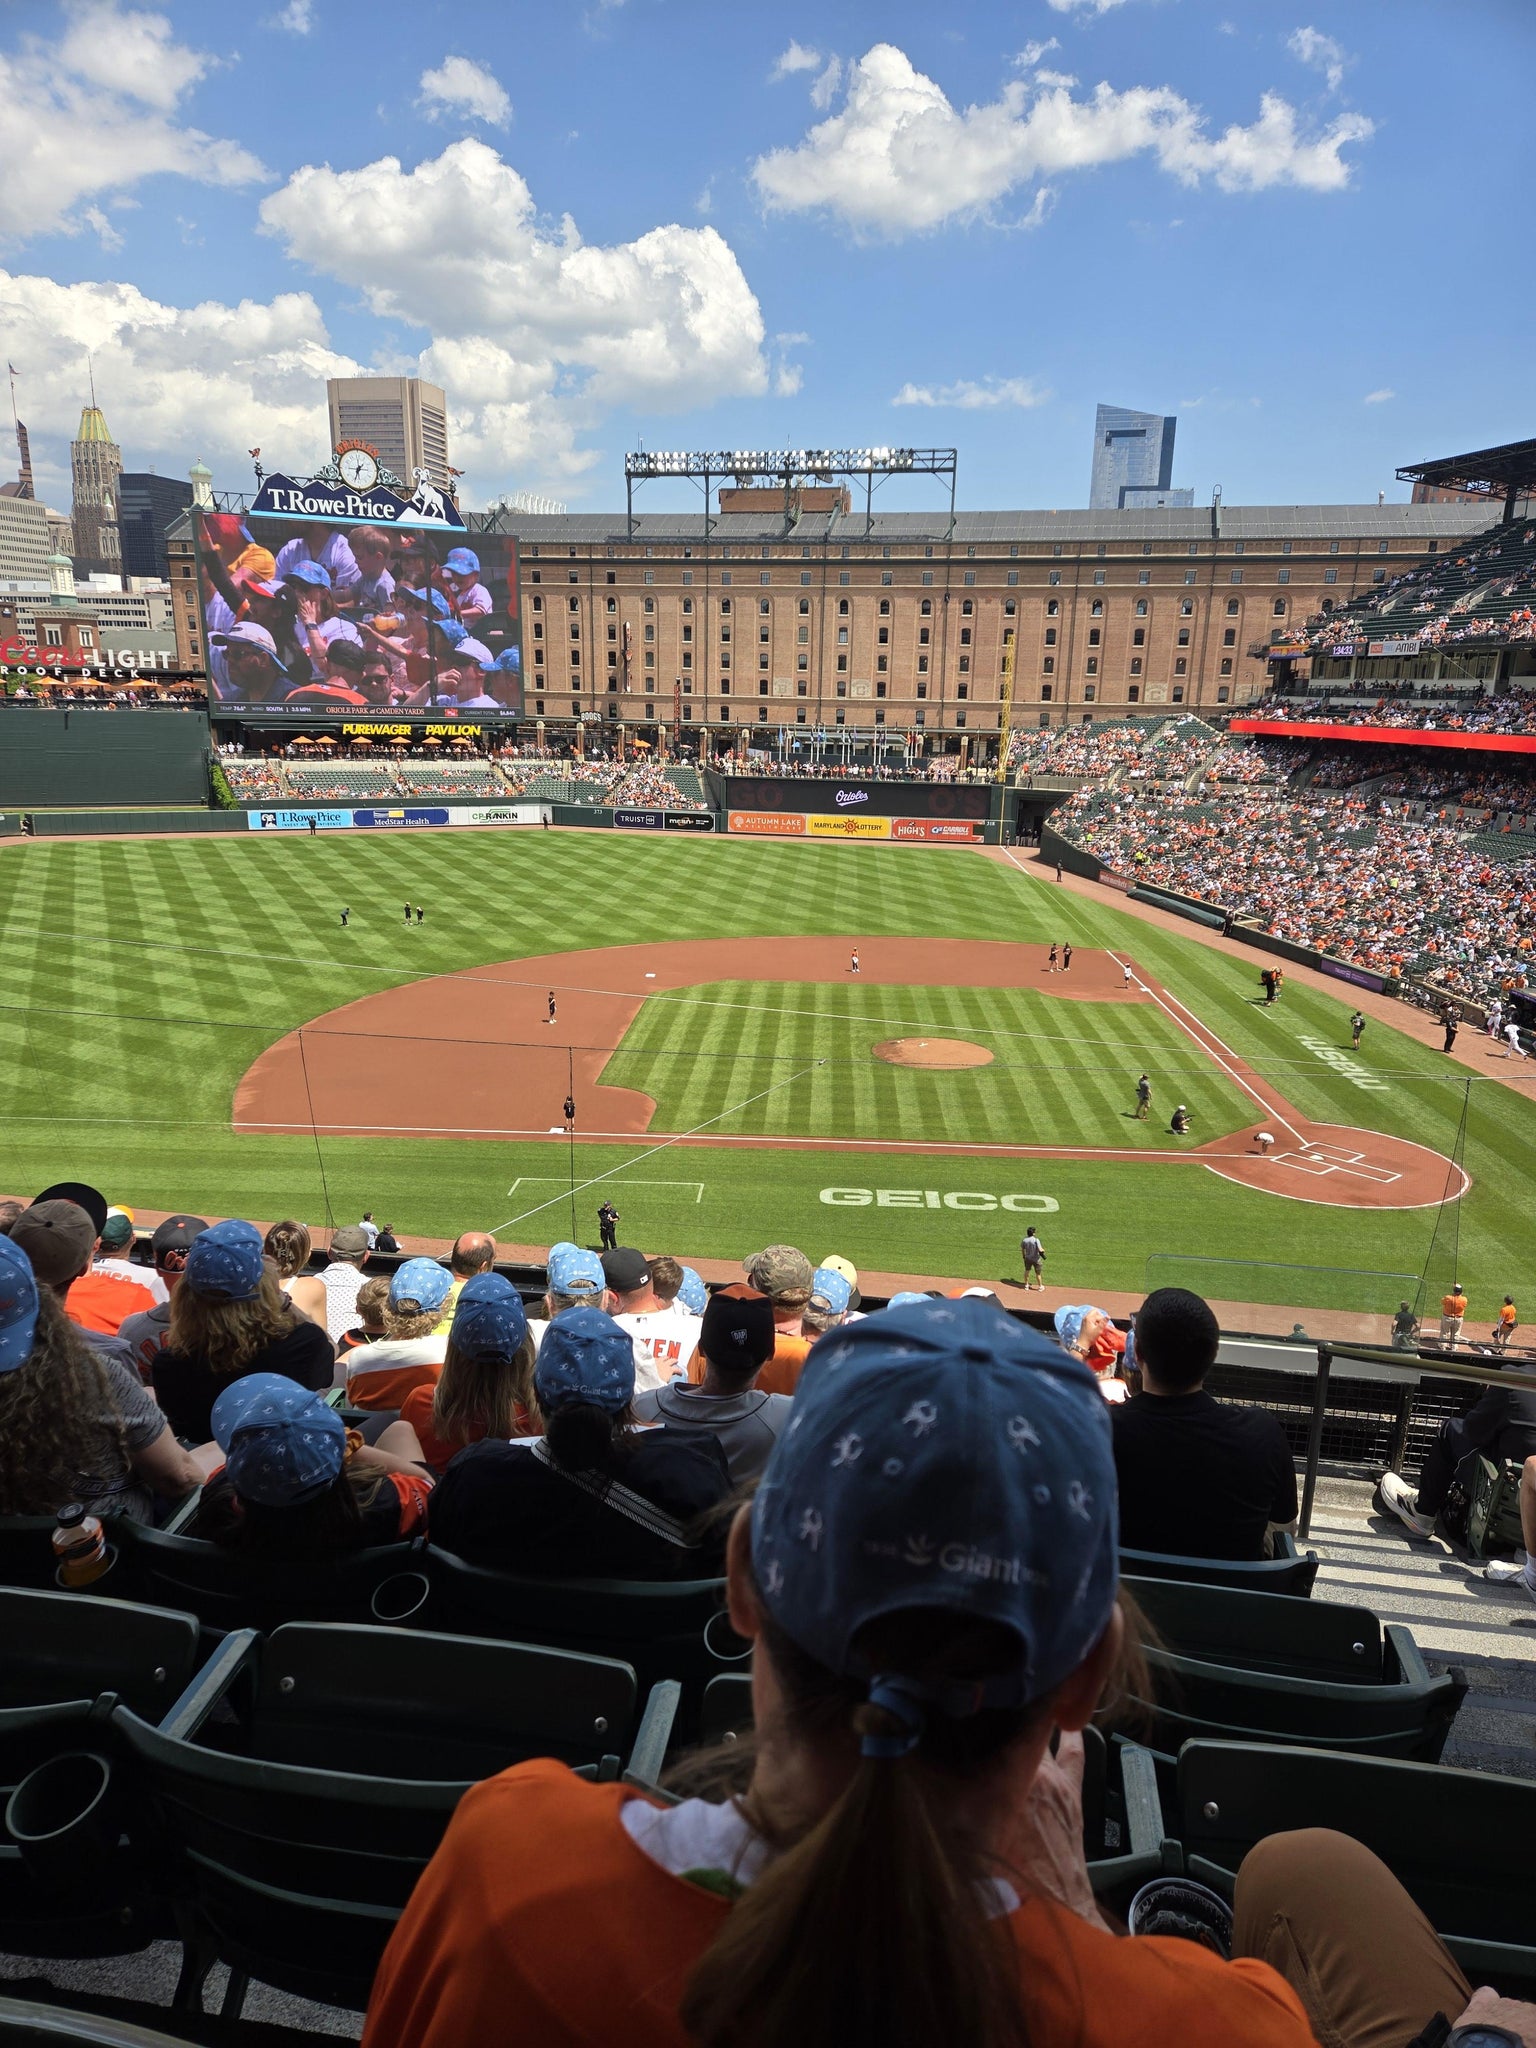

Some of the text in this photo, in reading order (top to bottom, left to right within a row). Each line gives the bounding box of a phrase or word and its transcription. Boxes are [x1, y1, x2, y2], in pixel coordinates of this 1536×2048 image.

[346, 494, 396, 520] Price
[0, 635, 171, 669] Coors LIGHT
[0, 665, 140, 678] ROOF DECK
[326, 706, 350, 714] ORIOLE
[404, 708, 425, 716] YARDS
[342, 723, 481, 736] PUREWAGER PAVILION
[835, 790, 869, 805] Orioles
[316, 811, 341, 821] Price
[374, 817, 430, 826] MedStar Health
[619, 815, 645, 823] TRUIST
[745, 817, 801, 827] AUTUMN LAKE
[814, 822, 844, 830] MARYLAND
[897, 825, 926, 838] HIGH'S
[819, 1187, 1061, 1213] GEICO
[938, 1541, 1022, 1586] Giant
